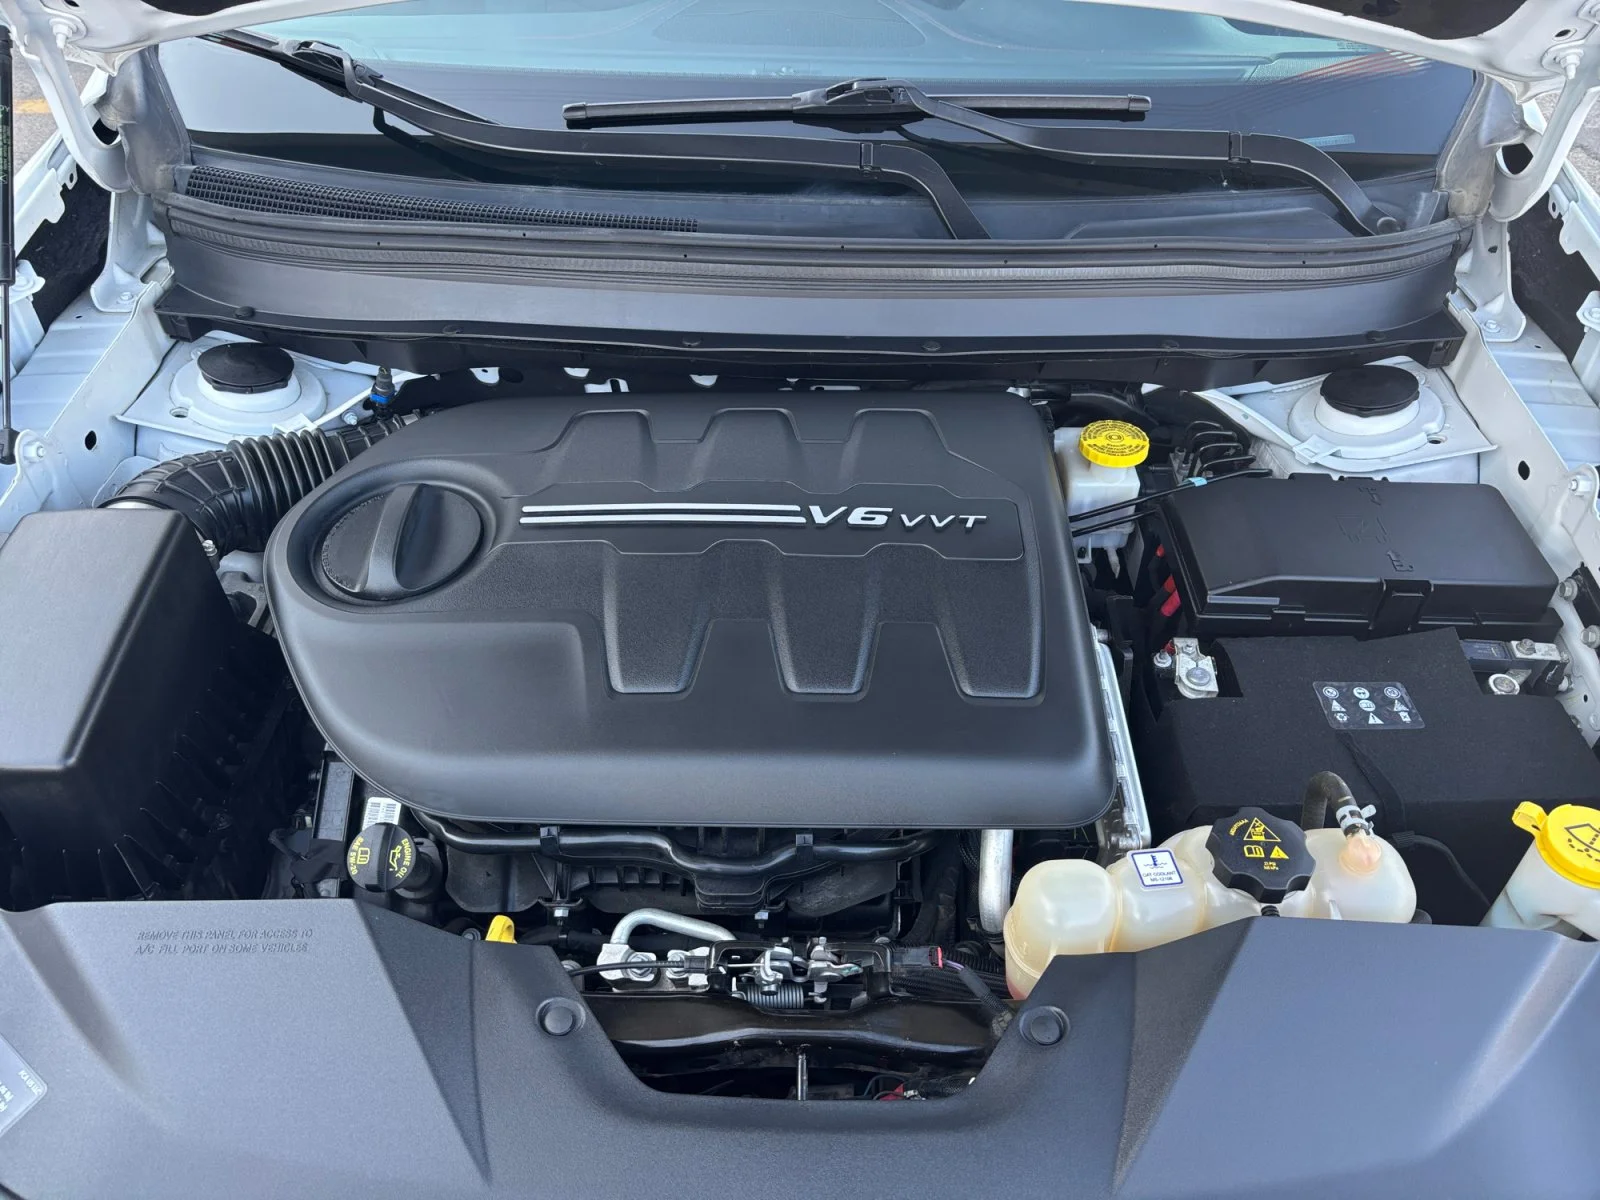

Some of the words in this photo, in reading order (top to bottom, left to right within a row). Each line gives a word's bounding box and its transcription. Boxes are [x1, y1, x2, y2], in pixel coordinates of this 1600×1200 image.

[808, 505, 894, 526] V6
[900, 513, 988, 529] VVT
[352, 836, 364, 850] SAE
[401, 838, 412, 866] ENGINE
[349, 852, 358, 875] 5W-20
[395, 866, 408, 878] OIL
[137, 929, 179, 941] REMOVE
[181, 929, 203, 940] THIS
[204, 929, 236, 940] PANEL
[237, 928, 258, 939] FOR
[259, 928, 298, 939] ACCESS
[301, 928, 313, 938] TO
[135, 943, 155, 954] A/C
[158, 943, 178, 954] FILL
[182, 943, 208, 954] PORT
[211, 943, 227, 953] ON
[229, 942, 258, 953] SOME
[260, 942, 308, 953] VEHICLES
